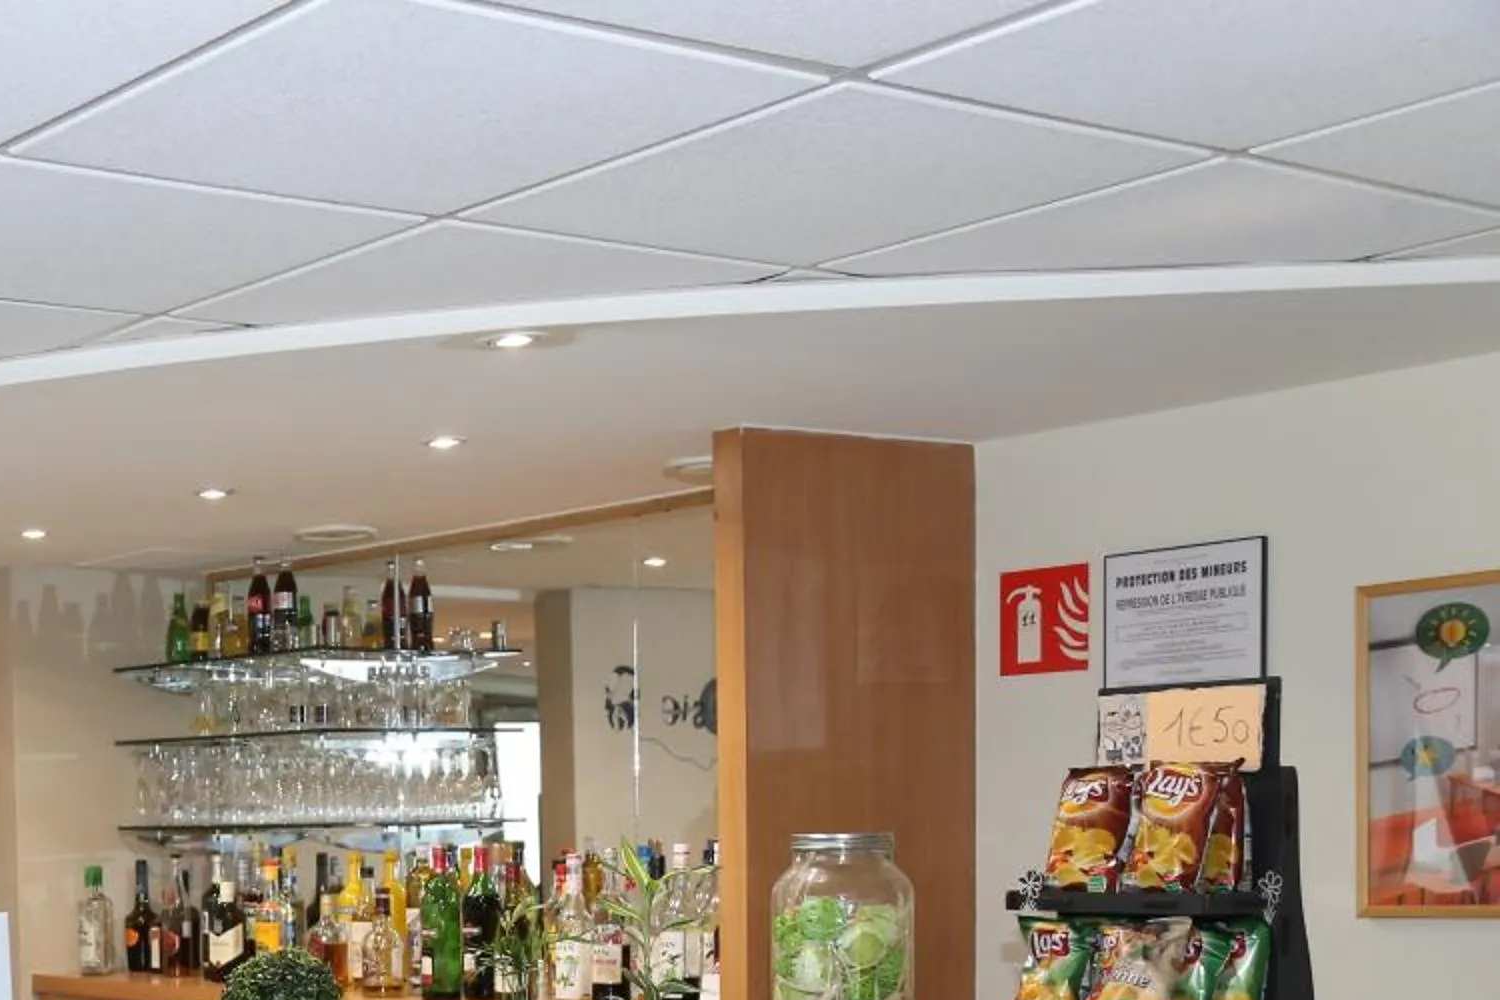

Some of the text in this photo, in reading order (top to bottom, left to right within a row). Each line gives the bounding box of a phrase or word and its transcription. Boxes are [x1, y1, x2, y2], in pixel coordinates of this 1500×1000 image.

[1115, 560, 1248, 589] PROTECTION DES MINEURS
[1146, 769, 1201, 806] Lay's
